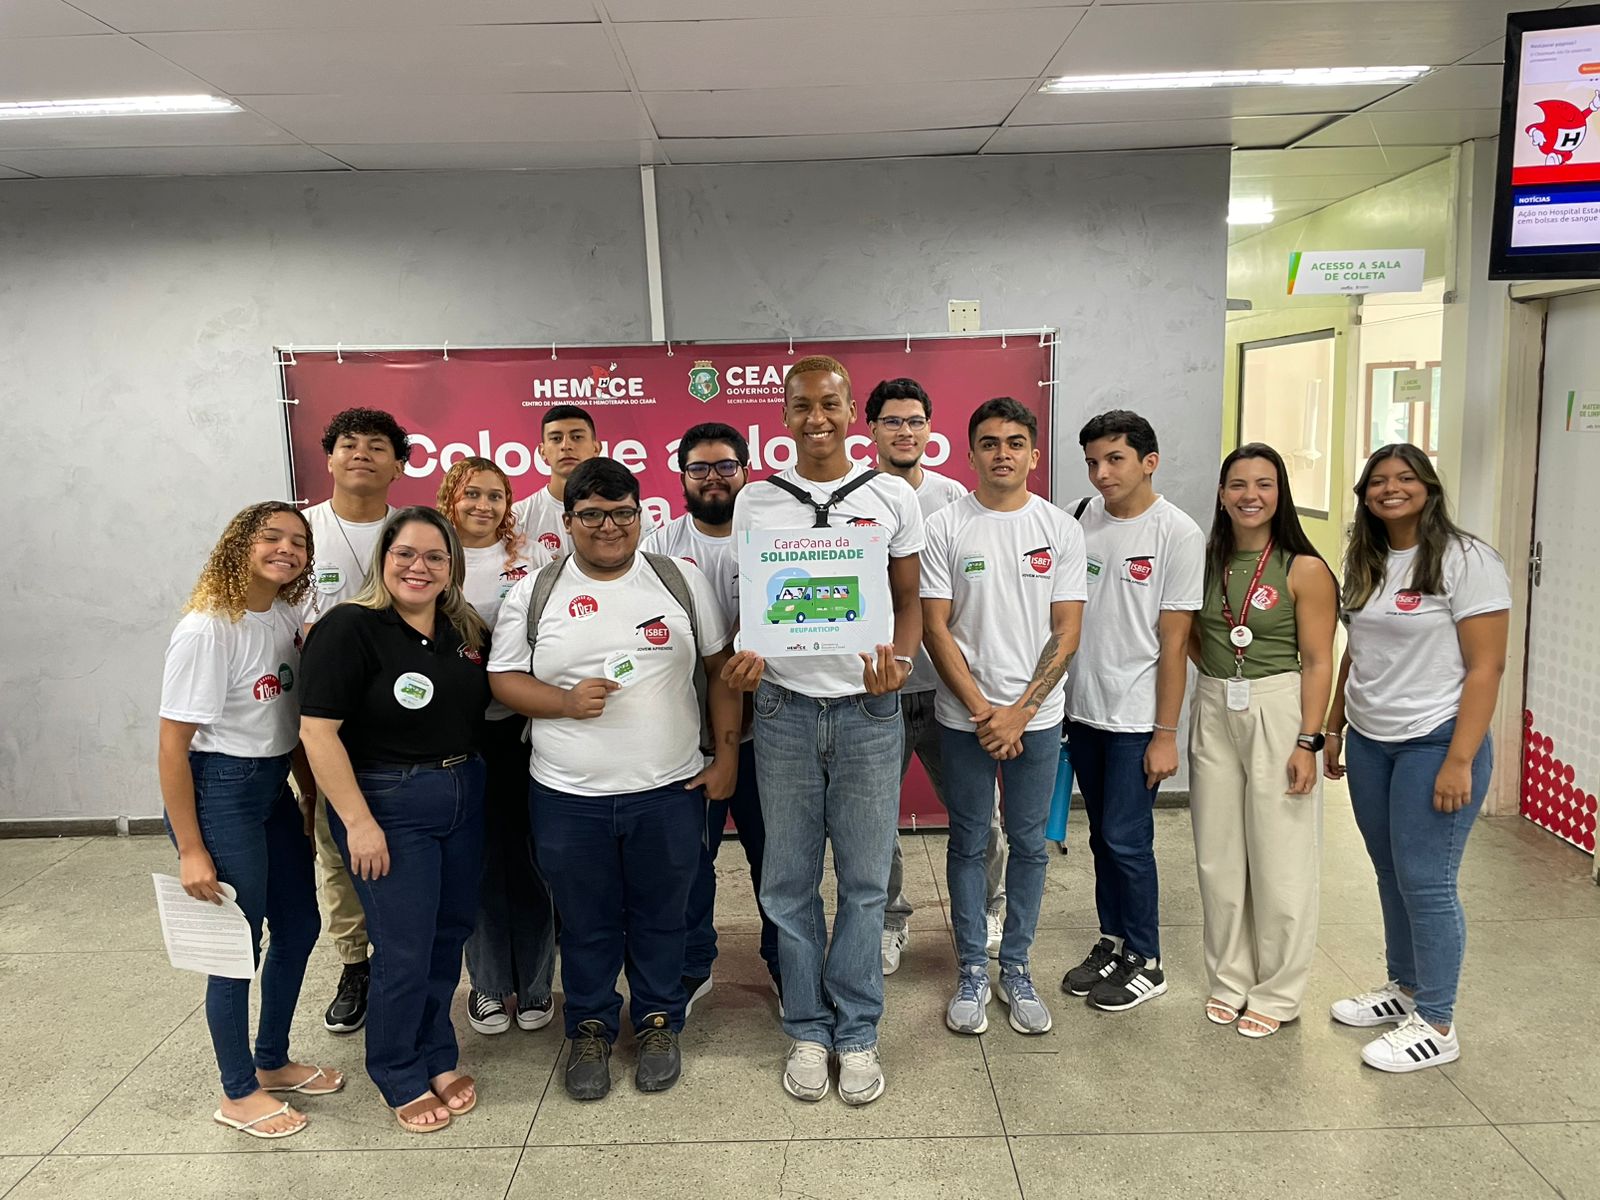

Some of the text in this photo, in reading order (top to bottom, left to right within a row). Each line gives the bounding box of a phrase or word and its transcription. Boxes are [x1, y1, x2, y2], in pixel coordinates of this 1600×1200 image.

[1561, 132, 1580, 147] H
[1519, 196, 1551, 204] NOTÍCIAS
[1518, 210, 1536, 218] Ação
[1549, 207, 1580, 218] Hospital
[1534, 216, 1558, 224] bolsas
[1571, 214, 1599, 222] sangue
[1311, 260, 1401, 271] ACESSO A SALA
[1324, 271, 1386, 281] DE COLETA
[533, 377, 644, 398] HEMCE
[726, 387, 770, 395] GOVERNO
[639, 397, 657, 405] CEARÁ
[835, 537, 850, 547] da
[760, 549, 864, 562] SOLIDARIEDADE
[1030, 557, 1051, 566] ISBET
[1130, 563, 1152, 574] ISBET
[645, 628, 668, 637] ISBET
